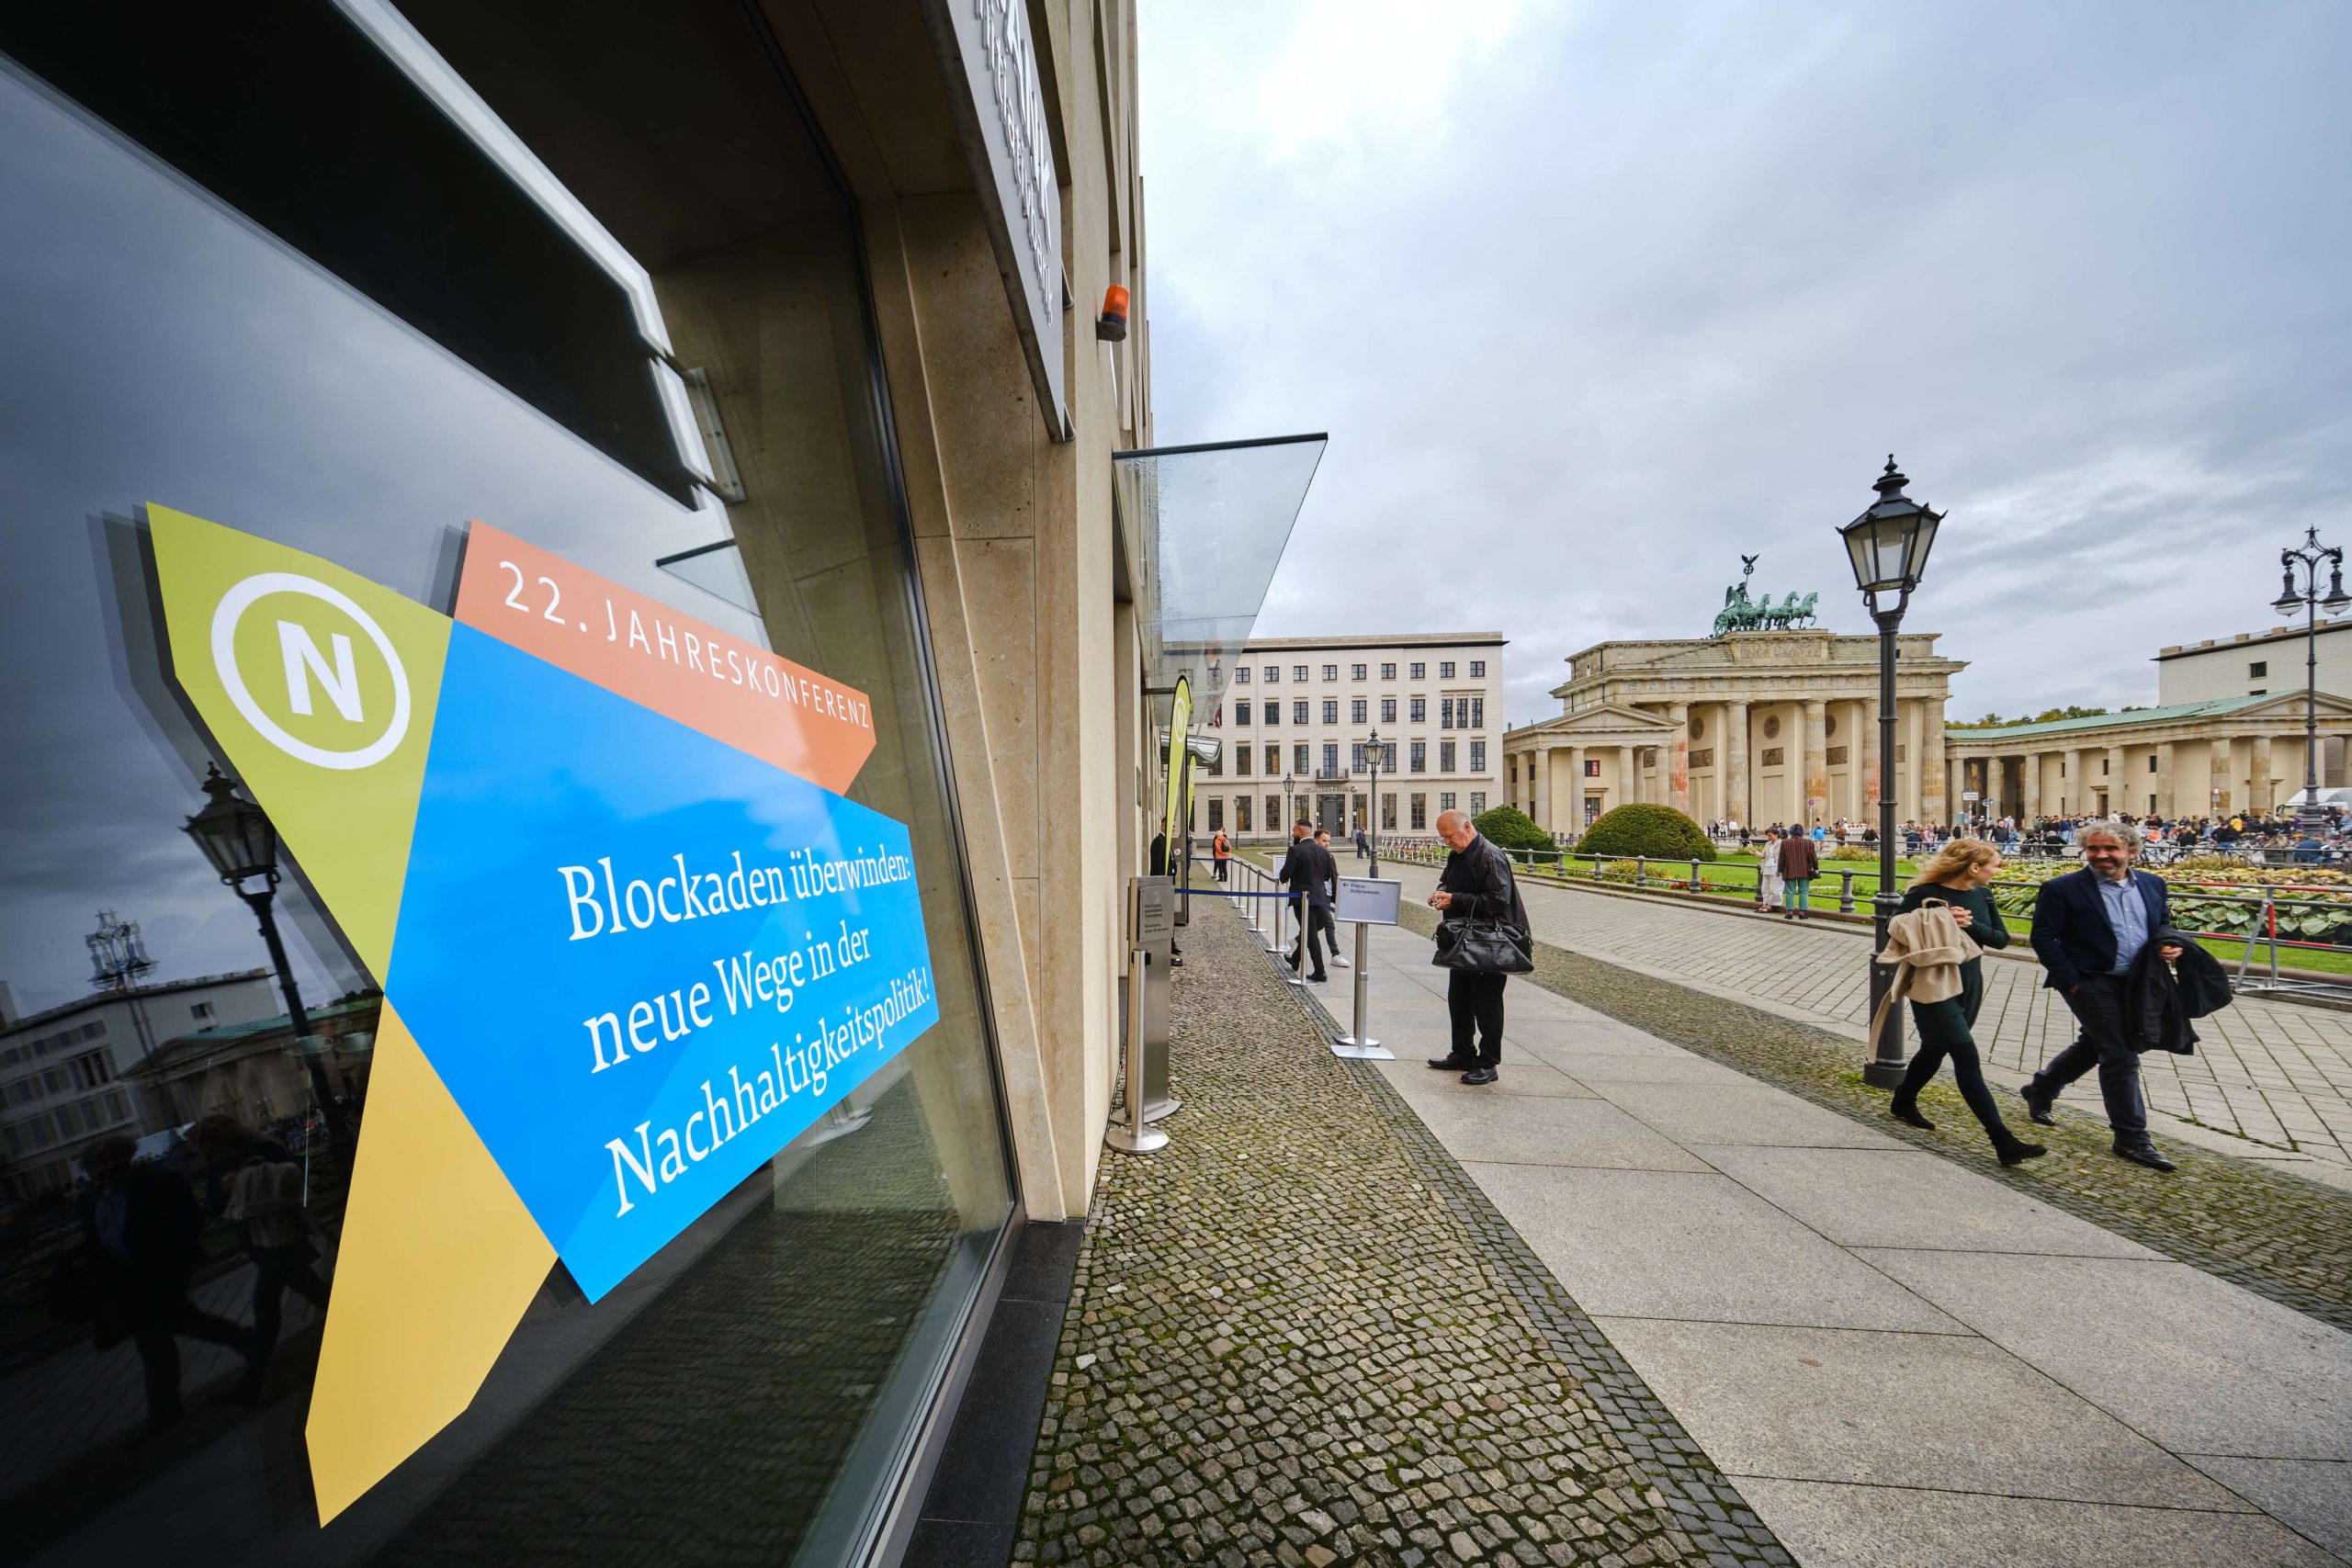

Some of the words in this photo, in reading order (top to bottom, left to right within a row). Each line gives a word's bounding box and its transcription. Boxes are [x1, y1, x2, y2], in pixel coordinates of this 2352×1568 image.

[994, 0, 1052, 254] ANK
[277, 620, 364, 723] N
[499, 560, 587, 633] 22.
[605, 599, 870, 728] JAHRESKONFERENZ
[558, 851, 788, 941] Blockaden
[789, 844, 911, 898] überwinden:
[583, 982, 713, 1074] neue
[713, 952, 805, 1013] Wege
[806, 931, 835, 980] in
[838, 919, 871, 967] der
[605, 967, 931, 1218] Nachhaltigkeitspolitik!
